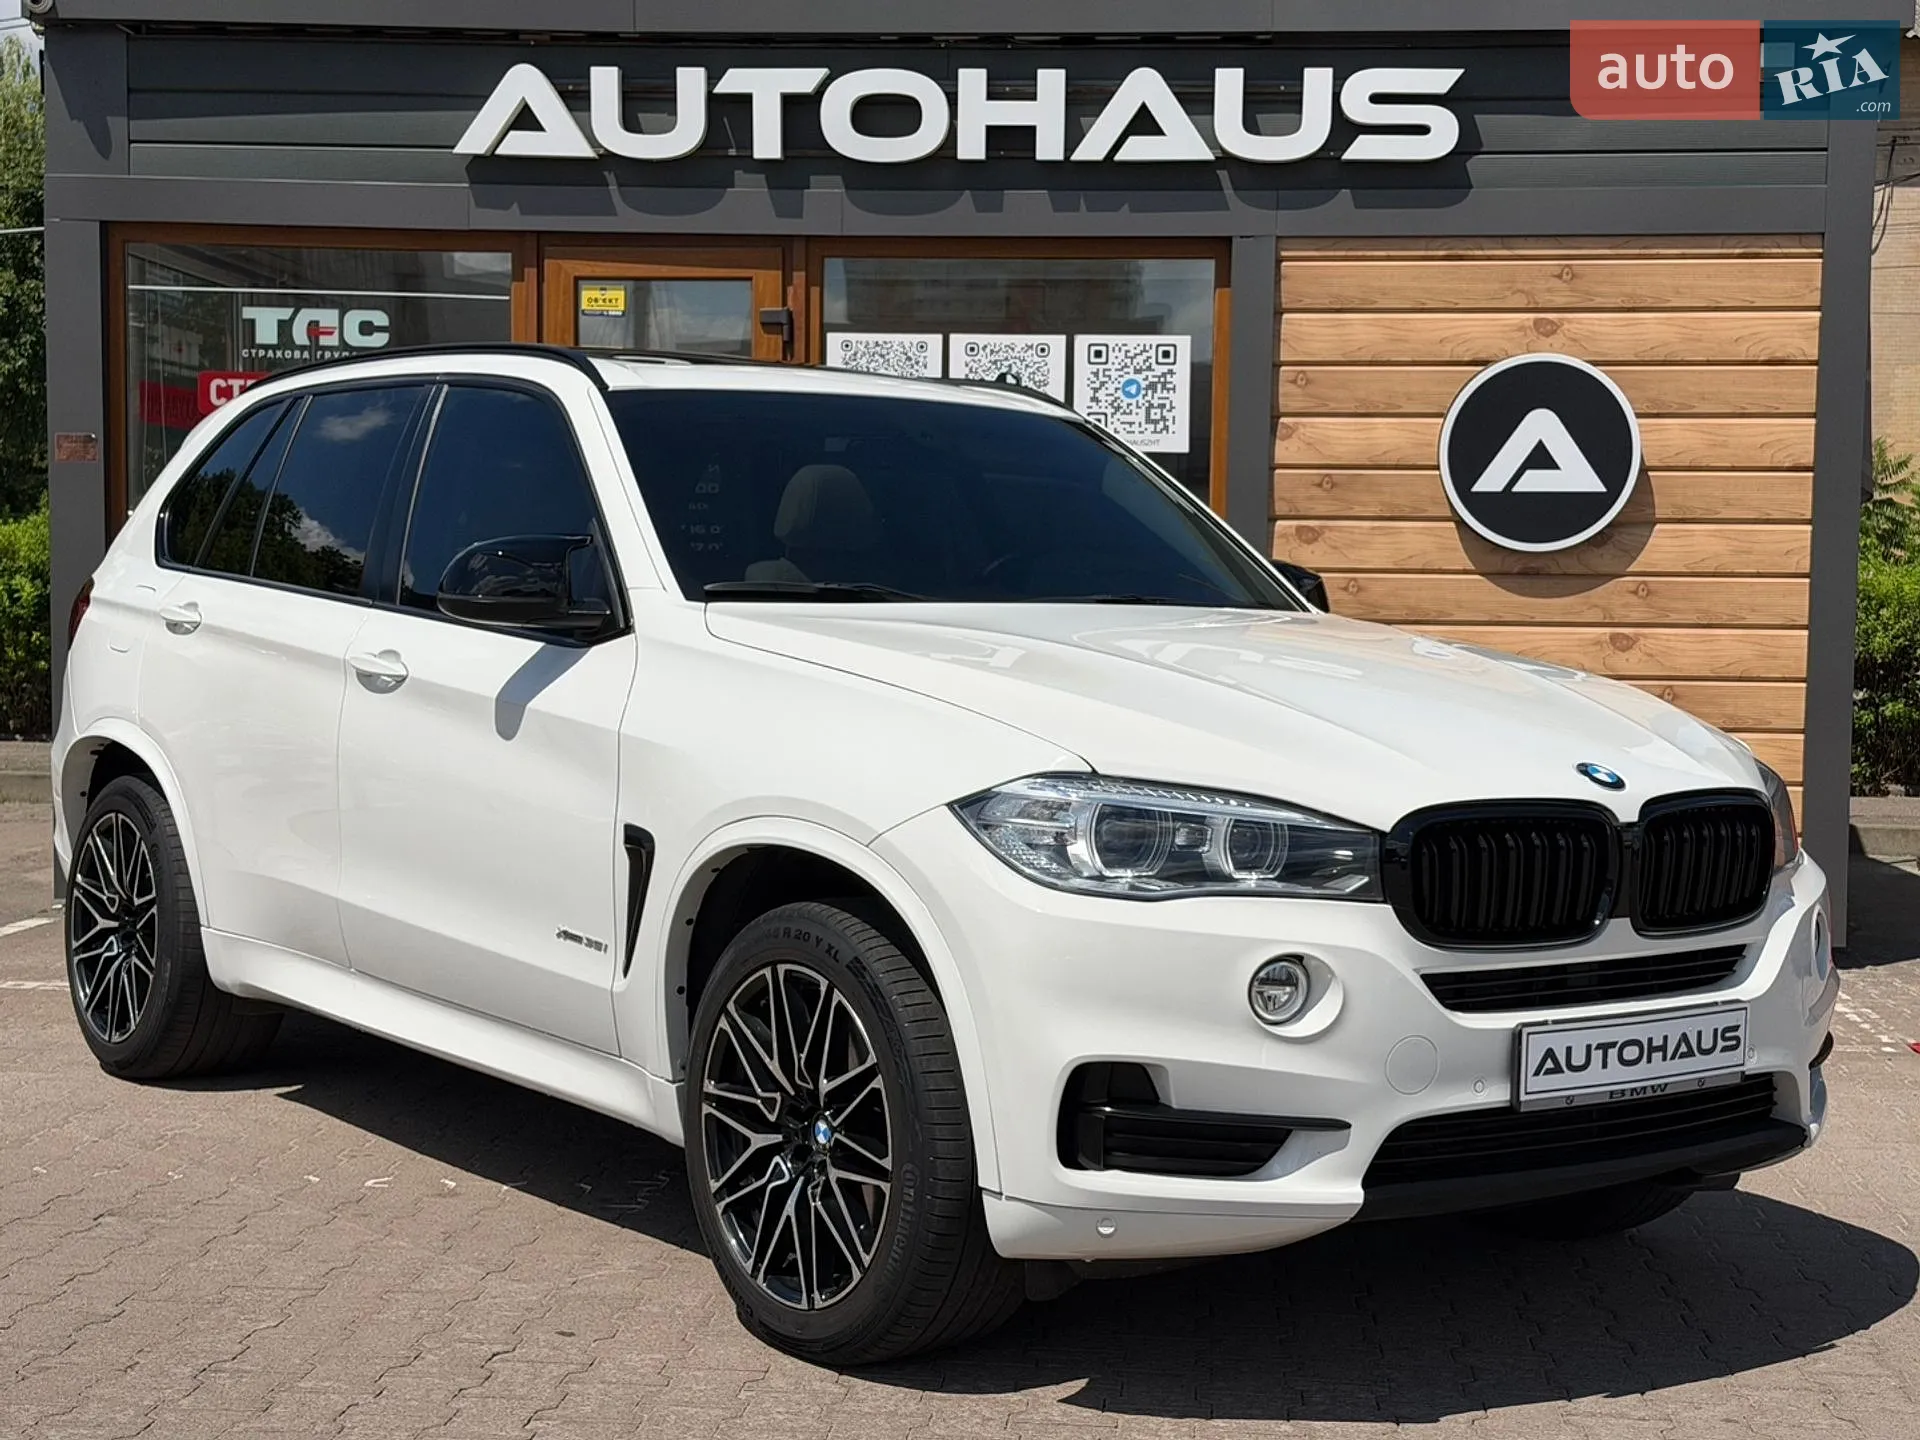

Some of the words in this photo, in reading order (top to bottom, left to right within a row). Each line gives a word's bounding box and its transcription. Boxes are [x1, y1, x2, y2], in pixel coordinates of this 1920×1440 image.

[452, 62, 1466, 163] AUTOHAUS
[241, 348, 310, 359] СТРАХОВА
[209, 378, 258, 407] СТ
[1470, 407, 1608, 493] A
[1532, 1024, 1741, 1077] AUTOHAUS
[1608, 1083, 1669, 1100] BMW
